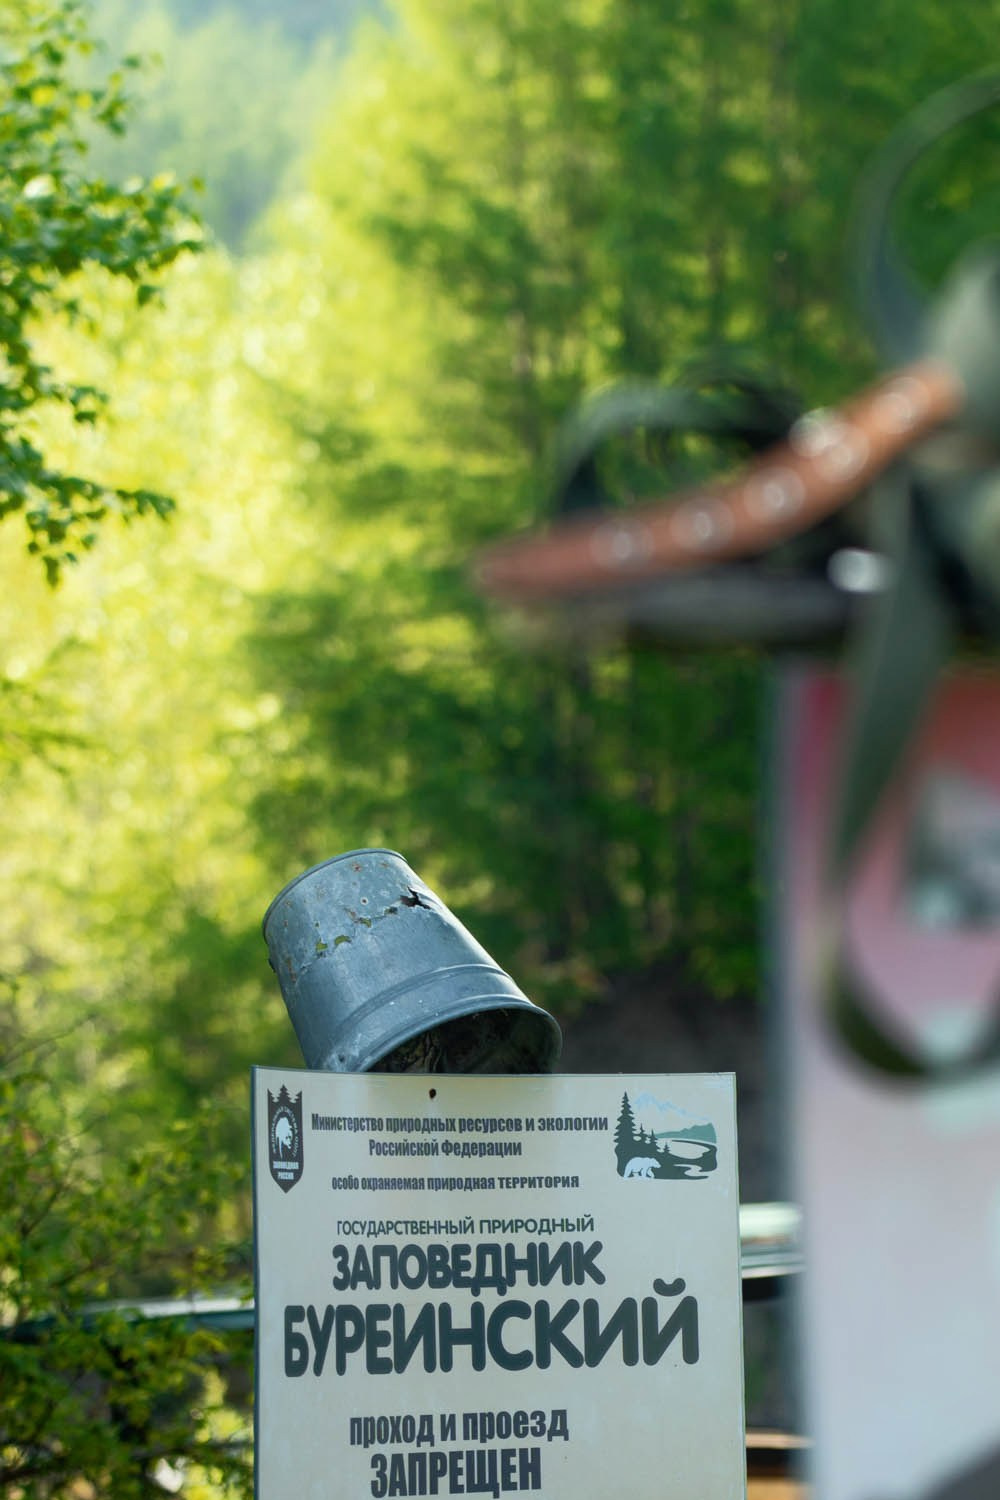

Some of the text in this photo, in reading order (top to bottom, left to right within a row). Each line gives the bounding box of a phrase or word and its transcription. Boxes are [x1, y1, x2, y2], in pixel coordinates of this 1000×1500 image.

[311, 1113, 384, 1133] Министерство
[385, 1117, 457, 1135] природных
[459, 1117, 523, 1134] ресурсов
[537, 1116, 609, 1132] экологии
[368, 1139, 523, 1158] Российской Федерации
[331, 1175, 580, 1192] особо охраняемая природная ТЕРРИТОРИЯ
[336, 1213, 595, 1238] ГОСУДАРСТВЕННЫЙ ПРИРОДНЫЙ
[332, 1240, 606, 1298] ЗАПОВЕДНИК
[283, 1277, 700, 1378] БУРЕИНСКИЙ
[349, 1413, 435, 1447] проход
[462, 1408, 569, 1442] проезд
[370, 1447, 542, 1500] ЗАПРЕЩЕН
